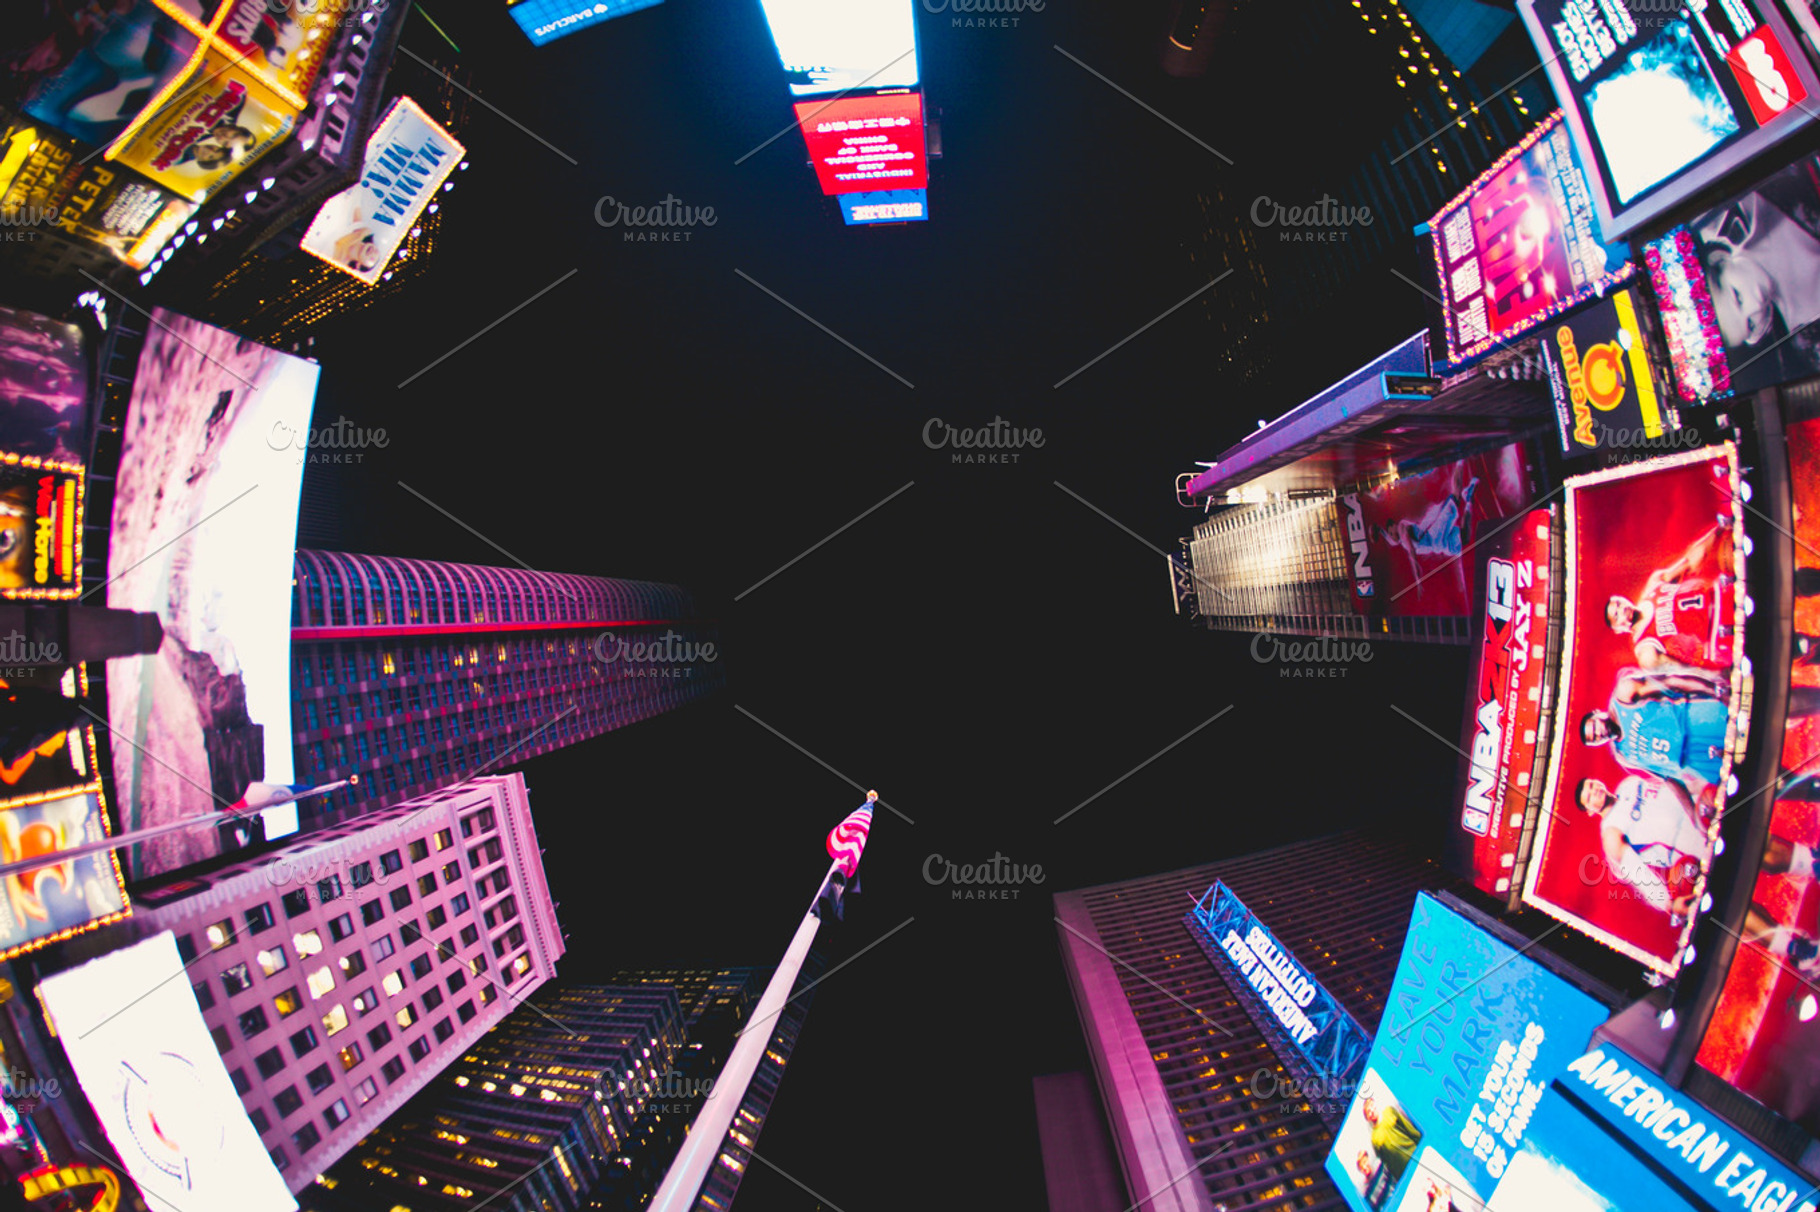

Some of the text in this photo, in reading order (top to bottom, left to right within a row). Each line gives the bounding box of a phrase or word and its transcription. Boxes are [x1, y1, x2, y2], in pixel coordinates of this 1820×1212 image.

[534, 7, 594, 38] BARCLAYS
[1551, 20, 1591, 82] ENJOY
[1560, 0, 1604, 71] MOVIES
[1574, 1, 1617, 58] BETTE
[194, 80, 245, 129] NICE
[148, 129, 205, 173] WORK
[360, 137, 417, 201] MIA!
[372, 136, 449, 227] MAMMA
[835, 167, 914, 182] INDUSTRIAL
[56, 165, 114, 235] PETER
[1468, 157, 1552, 333] EVITA
[1556, 326, 1595, 445] Avenue
[1585, 339, 1625, 410] Q
[1343, 492, 1372, 578] NBA
[1490, 560, 1532, 838] EXECUTIVE PRODUCED BY JAY Z
[1649, 736, 1671, 762] 35
[1249, 963, 1318, 1044] AMERICAN
[1381, 934, 1437, 1067] LEAVE
[1410, 960, 1468, 1075] YOUR
[1433, 984, 1503, 1125] MARK
[1473, 1021, 1545, 1162] 15 SECONDS
[1460, 1040, 1517, 1149] GET YOUR
[1567, 1050, 1820, 1212] AMERICAN EAGL
[1486, 1145, 1508, 1179] OF
